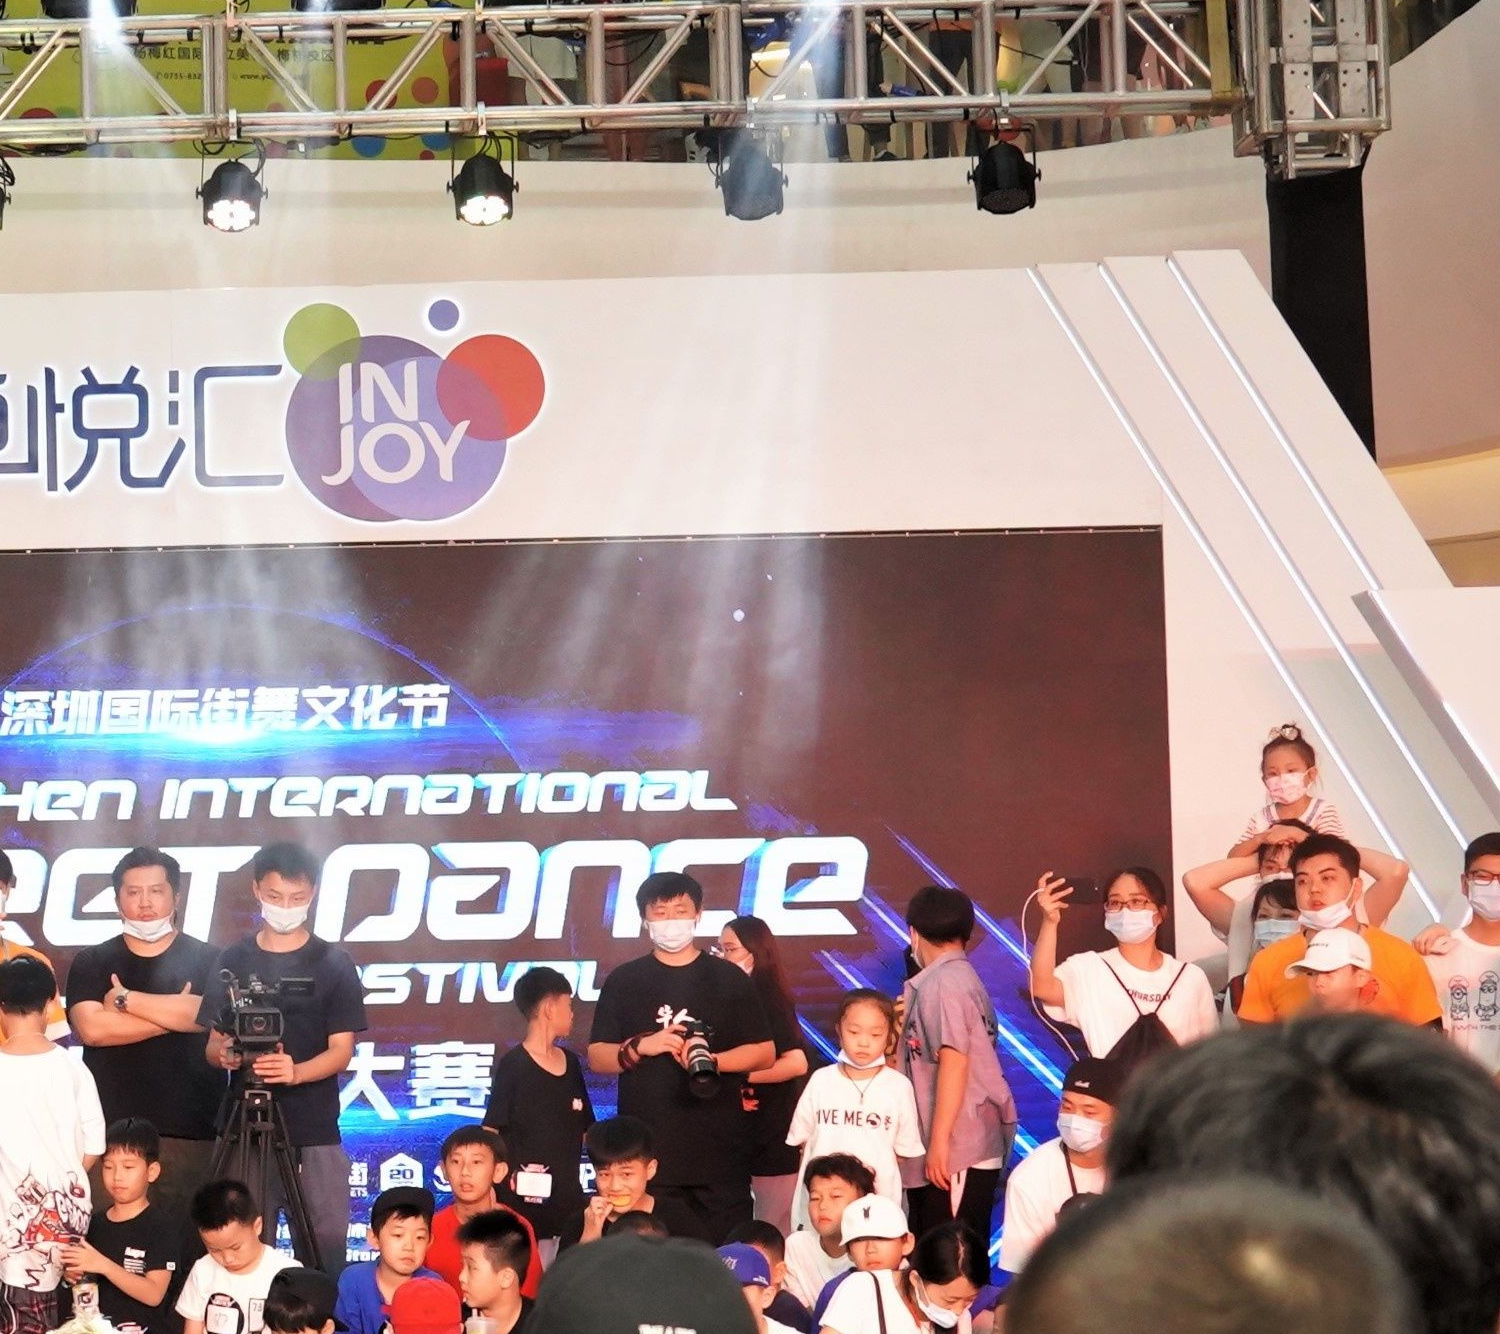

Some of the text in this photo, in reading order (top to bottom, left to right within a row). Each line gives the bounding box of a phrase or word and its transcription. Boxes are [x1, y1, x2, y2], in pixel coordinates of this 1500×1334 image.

[337, 360, 419, 424] IN
[321, 419, 470, 486] JOY
[843, 1109, 863, 1127] ME
[389, 1168, 414, 1181] 20
